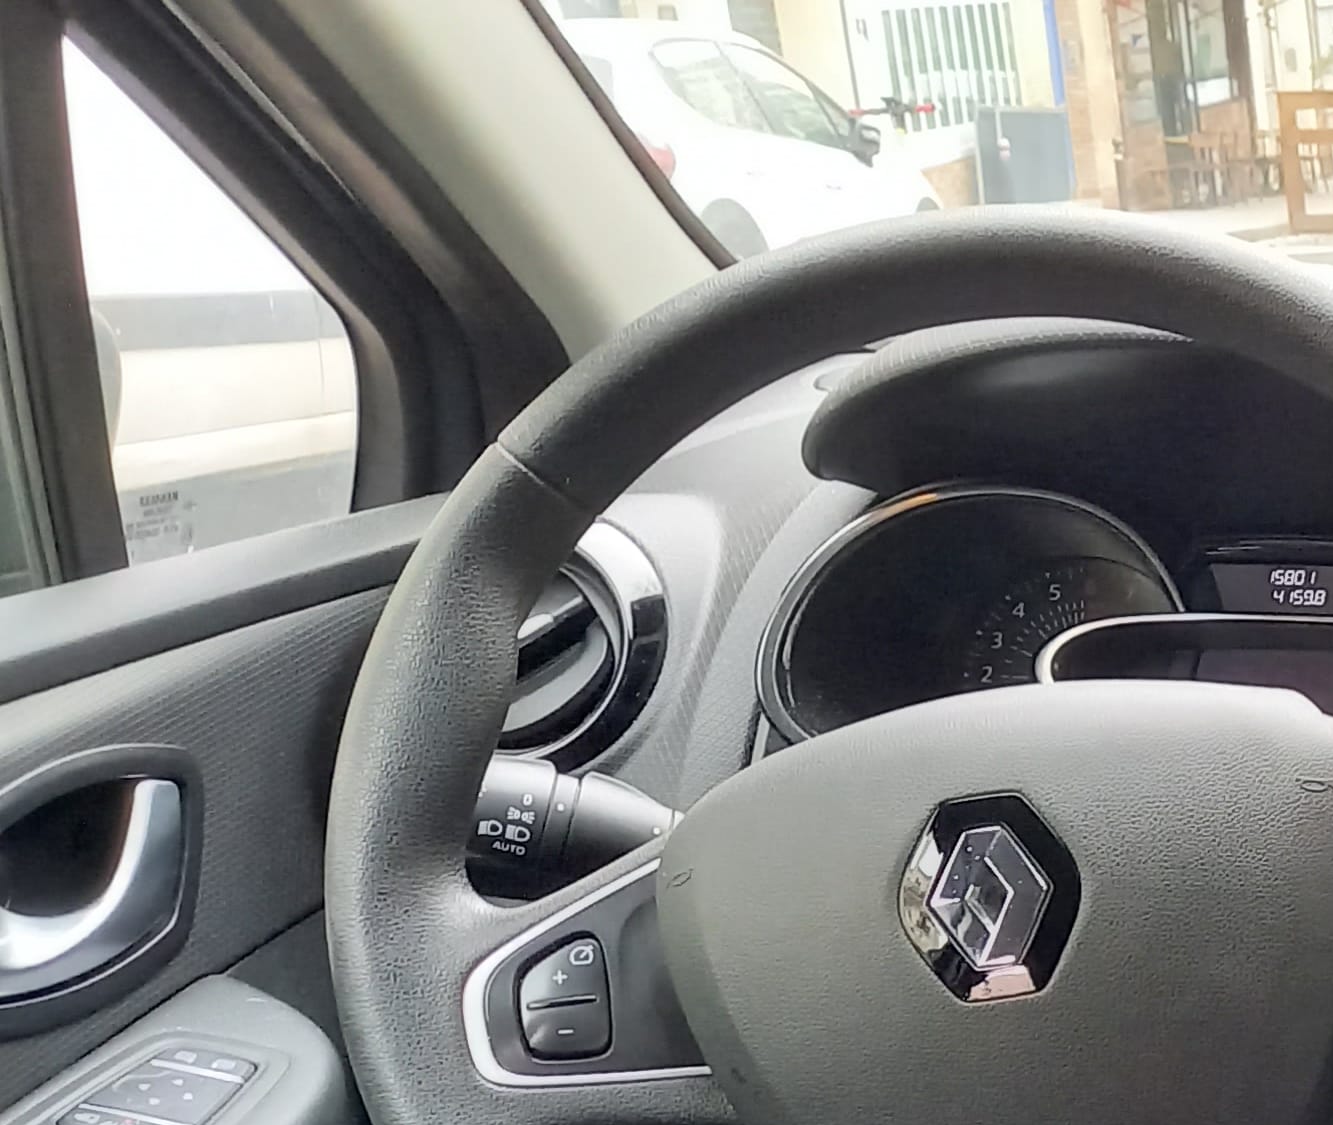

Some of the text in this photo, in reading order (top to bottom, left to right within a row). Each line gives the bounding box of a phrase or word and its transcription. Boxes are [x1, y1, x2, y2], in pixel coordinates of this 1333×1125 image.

[1049, 584, 1061, 601] 5
[1012, 602, 1025, 618] 4
[991, 632, 1003, 649] 3
[981, 666, 993, 683] 2
[492, 841, 526, 856] AUTO
